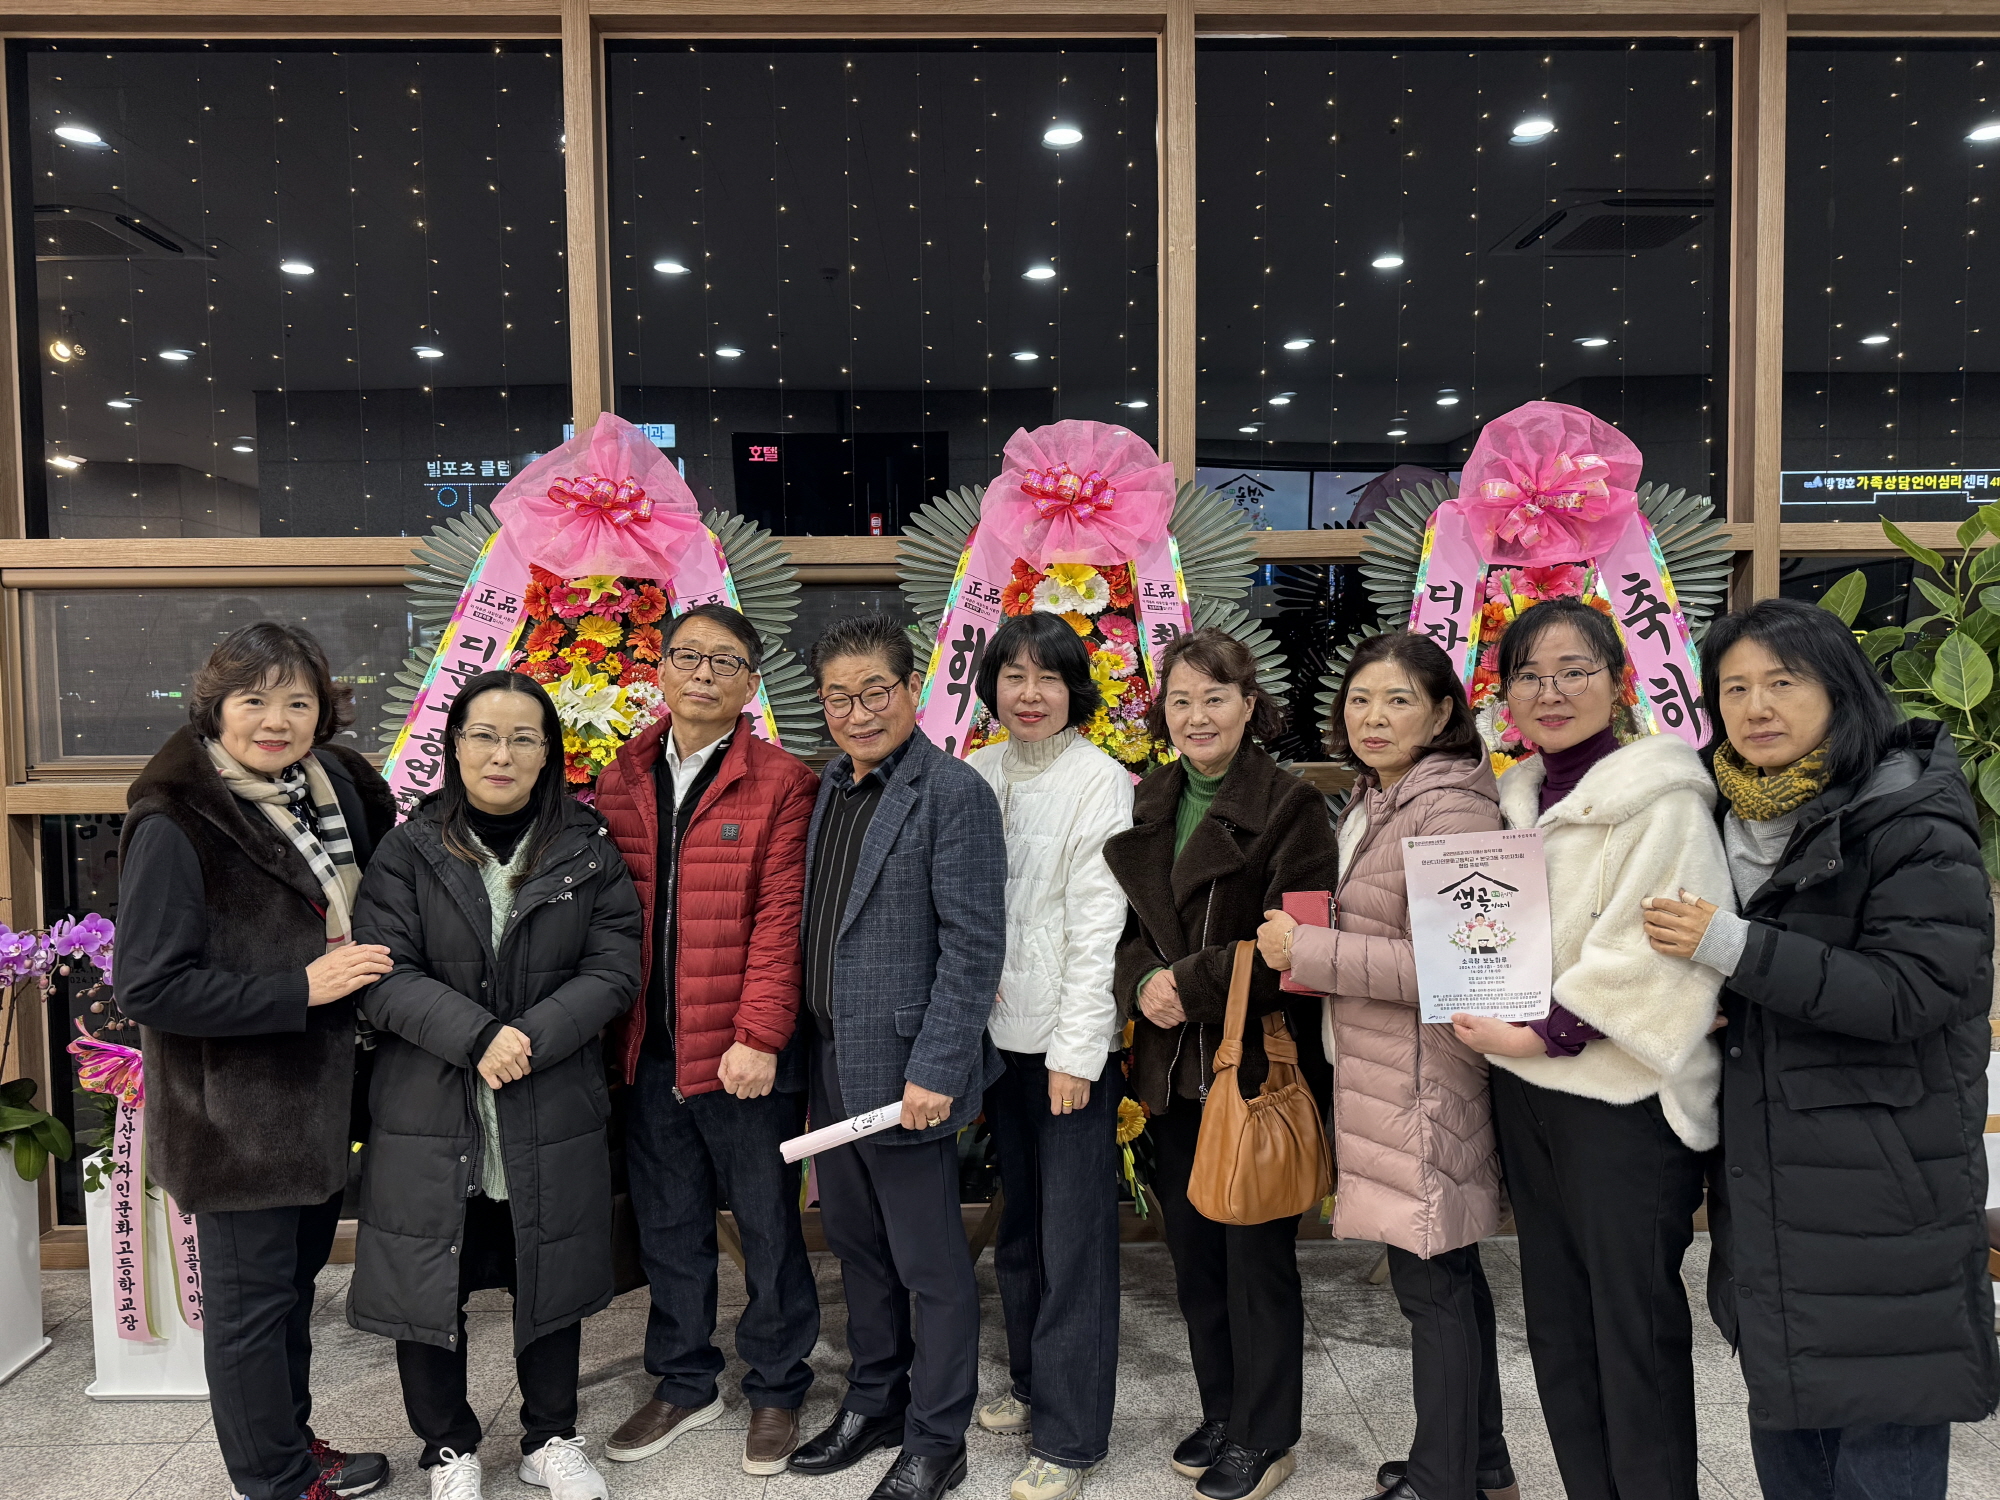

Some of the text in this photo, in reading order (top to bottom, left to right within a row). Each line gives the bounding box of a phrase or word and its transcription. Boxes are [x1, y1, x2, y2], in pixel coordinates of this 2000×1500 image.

[748, 445, 778, 462] 호텔
[426, 460, 476, 478] 빌포츠
[474, 588, 518, 614] 正品
[964, 581, 1002, 605] 正品
[1142, 582, 1175, 599] 正品
[1621, 572, 1705, 742] 축하
[1453, 886, 1491, 913] 샘골
[1491, 901, 1510, 909] 이야기
[114, 1104, 139, 1333] 안산디자인문화고등학교장
